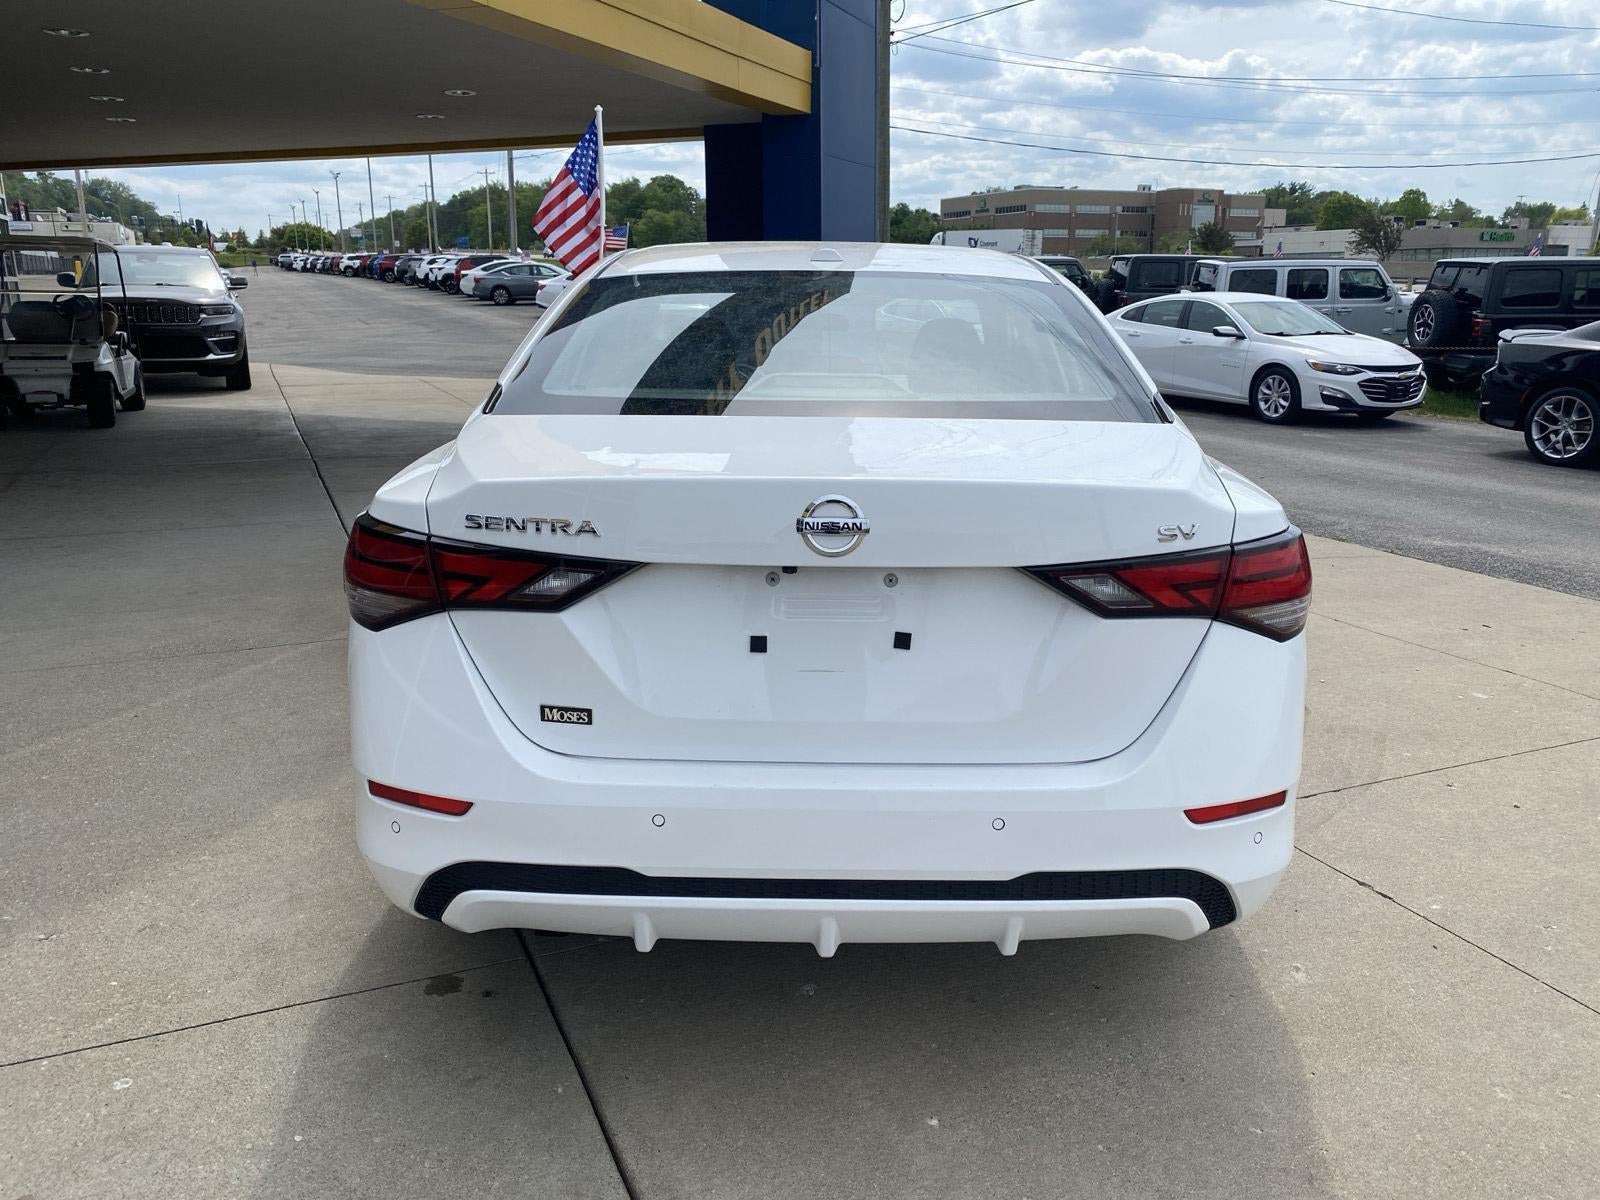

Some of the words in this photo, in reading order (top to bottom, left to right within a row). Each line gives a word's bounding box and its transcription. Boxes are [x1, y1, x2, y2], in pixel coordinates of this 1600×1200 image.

[464, 514, 601, 538] SENTRA
[804, 521, 864, 532] NISSAN
[1157, 523, 1200, 543] SV
[543, 707, 589, 723] MOSES
